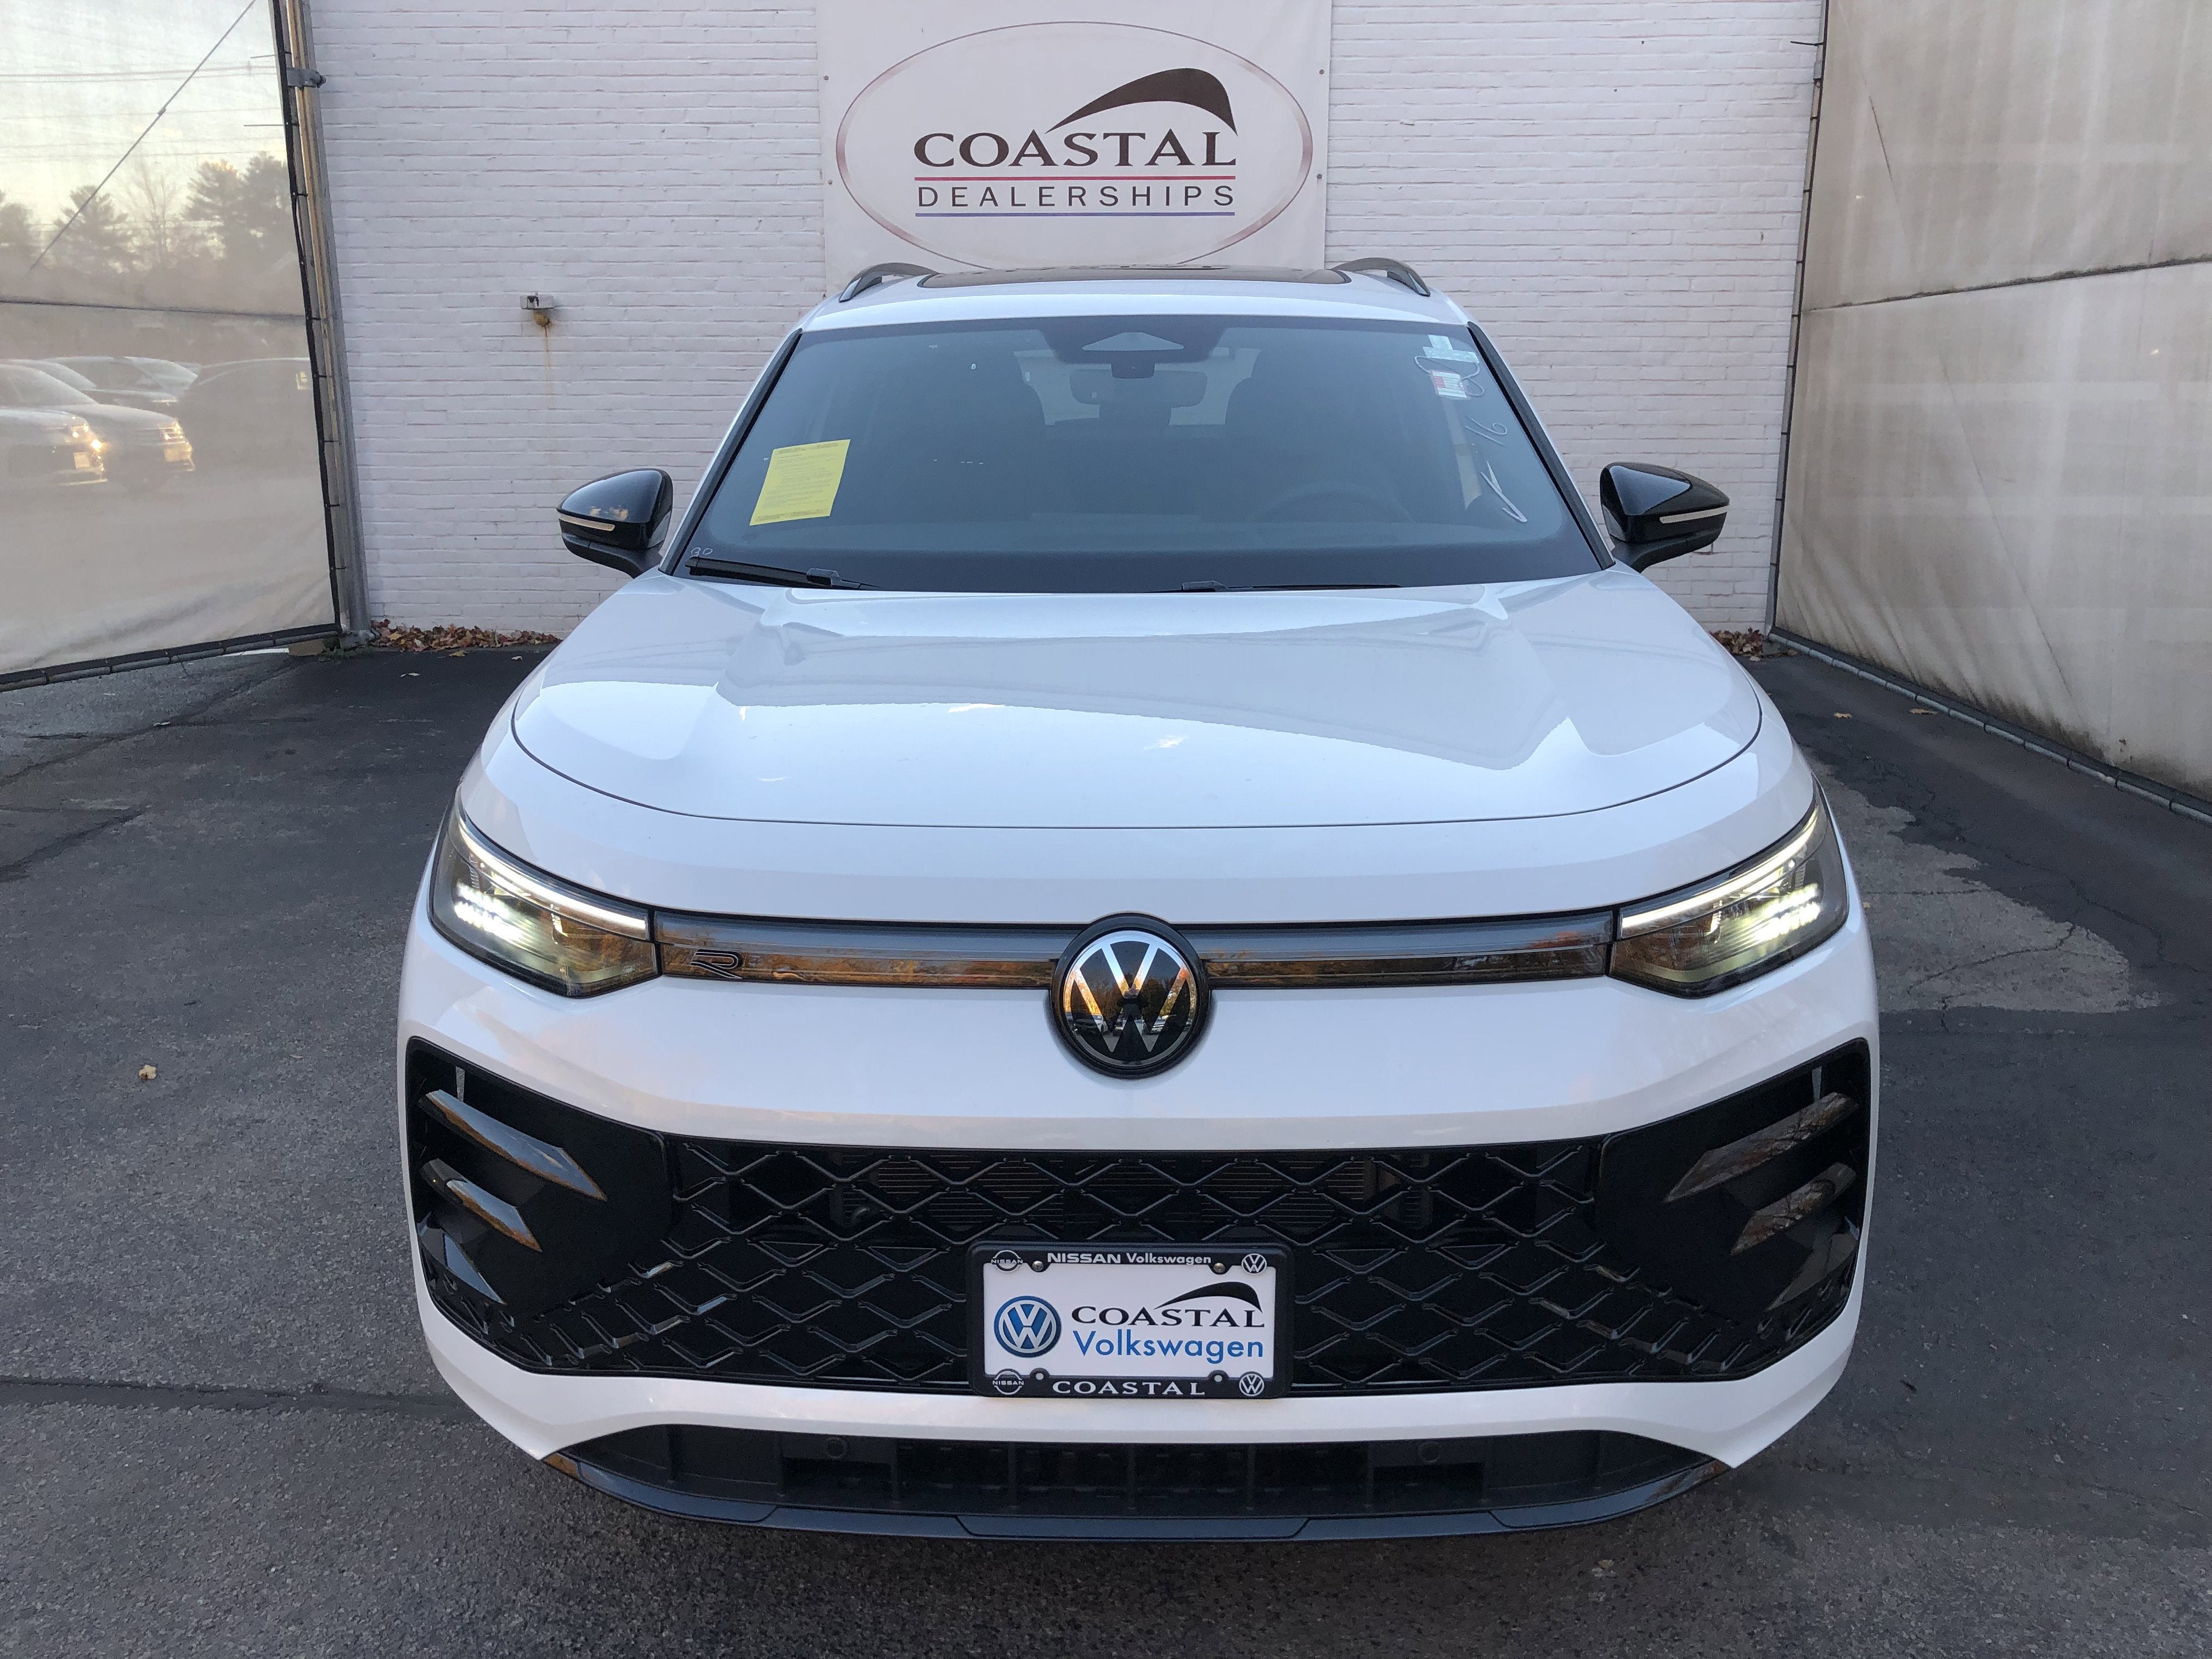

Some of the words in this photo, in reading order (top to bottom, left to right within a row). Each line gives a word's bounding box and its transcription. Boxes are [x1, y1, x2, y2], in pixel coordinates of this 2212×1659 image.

[914, 128, 1237, 167] COASTAL
[918, 185, 1234, 207] DEALERSHIPS
[1047, 1252, 1121, 1263] NISSAN
[1126, 1252, 1211, 1266] Volkswagen
[1071, 1306, 1265, 1328] COASTAL
[1072, 1329, 1263, 1364] Volkswagen
[1052, 1381, 1206, 1396] COASTAL
